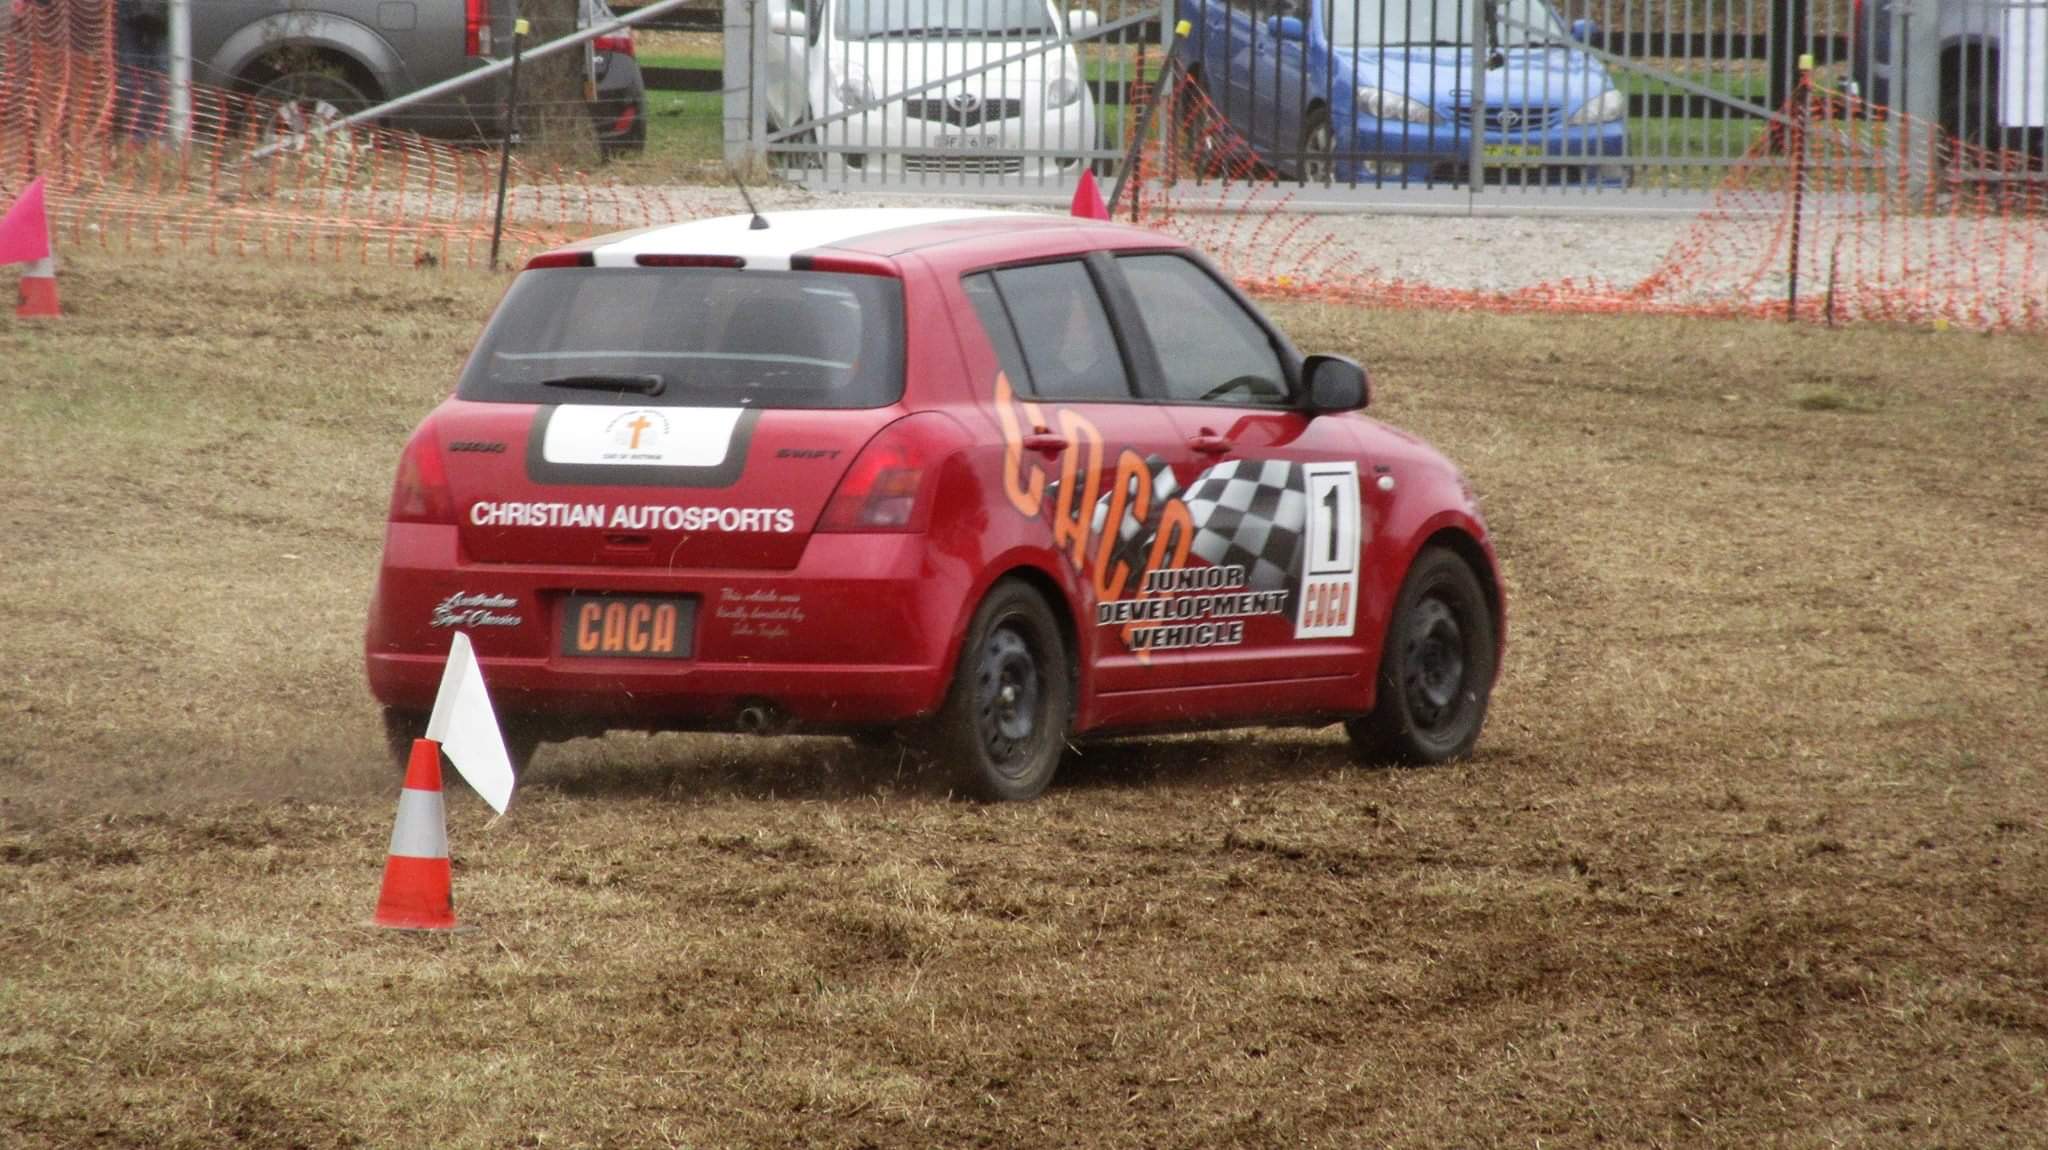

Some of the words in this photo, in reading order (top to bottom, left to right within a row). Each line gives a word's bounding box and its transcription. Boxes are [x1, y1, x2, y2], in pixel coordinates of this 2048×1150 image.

[776, 448, 841, 459] SWIFT
[470, 501, 605, 527] CHRISTIAN
[609, 504, 795, 533] AUTOSPORTS
[995, 370, 1193, 663] CACA
[1322, 484, 1340, 563] 1
[1143, 564, 1246, 594] JUNIOR
[1096, 589, 1290, 627] DEVELOPMENT
[1303, 582, 1350, 629] CACA
[577, 601, 677, 653] CACA
[1129, 620, 1246, 652] VEHICLE
